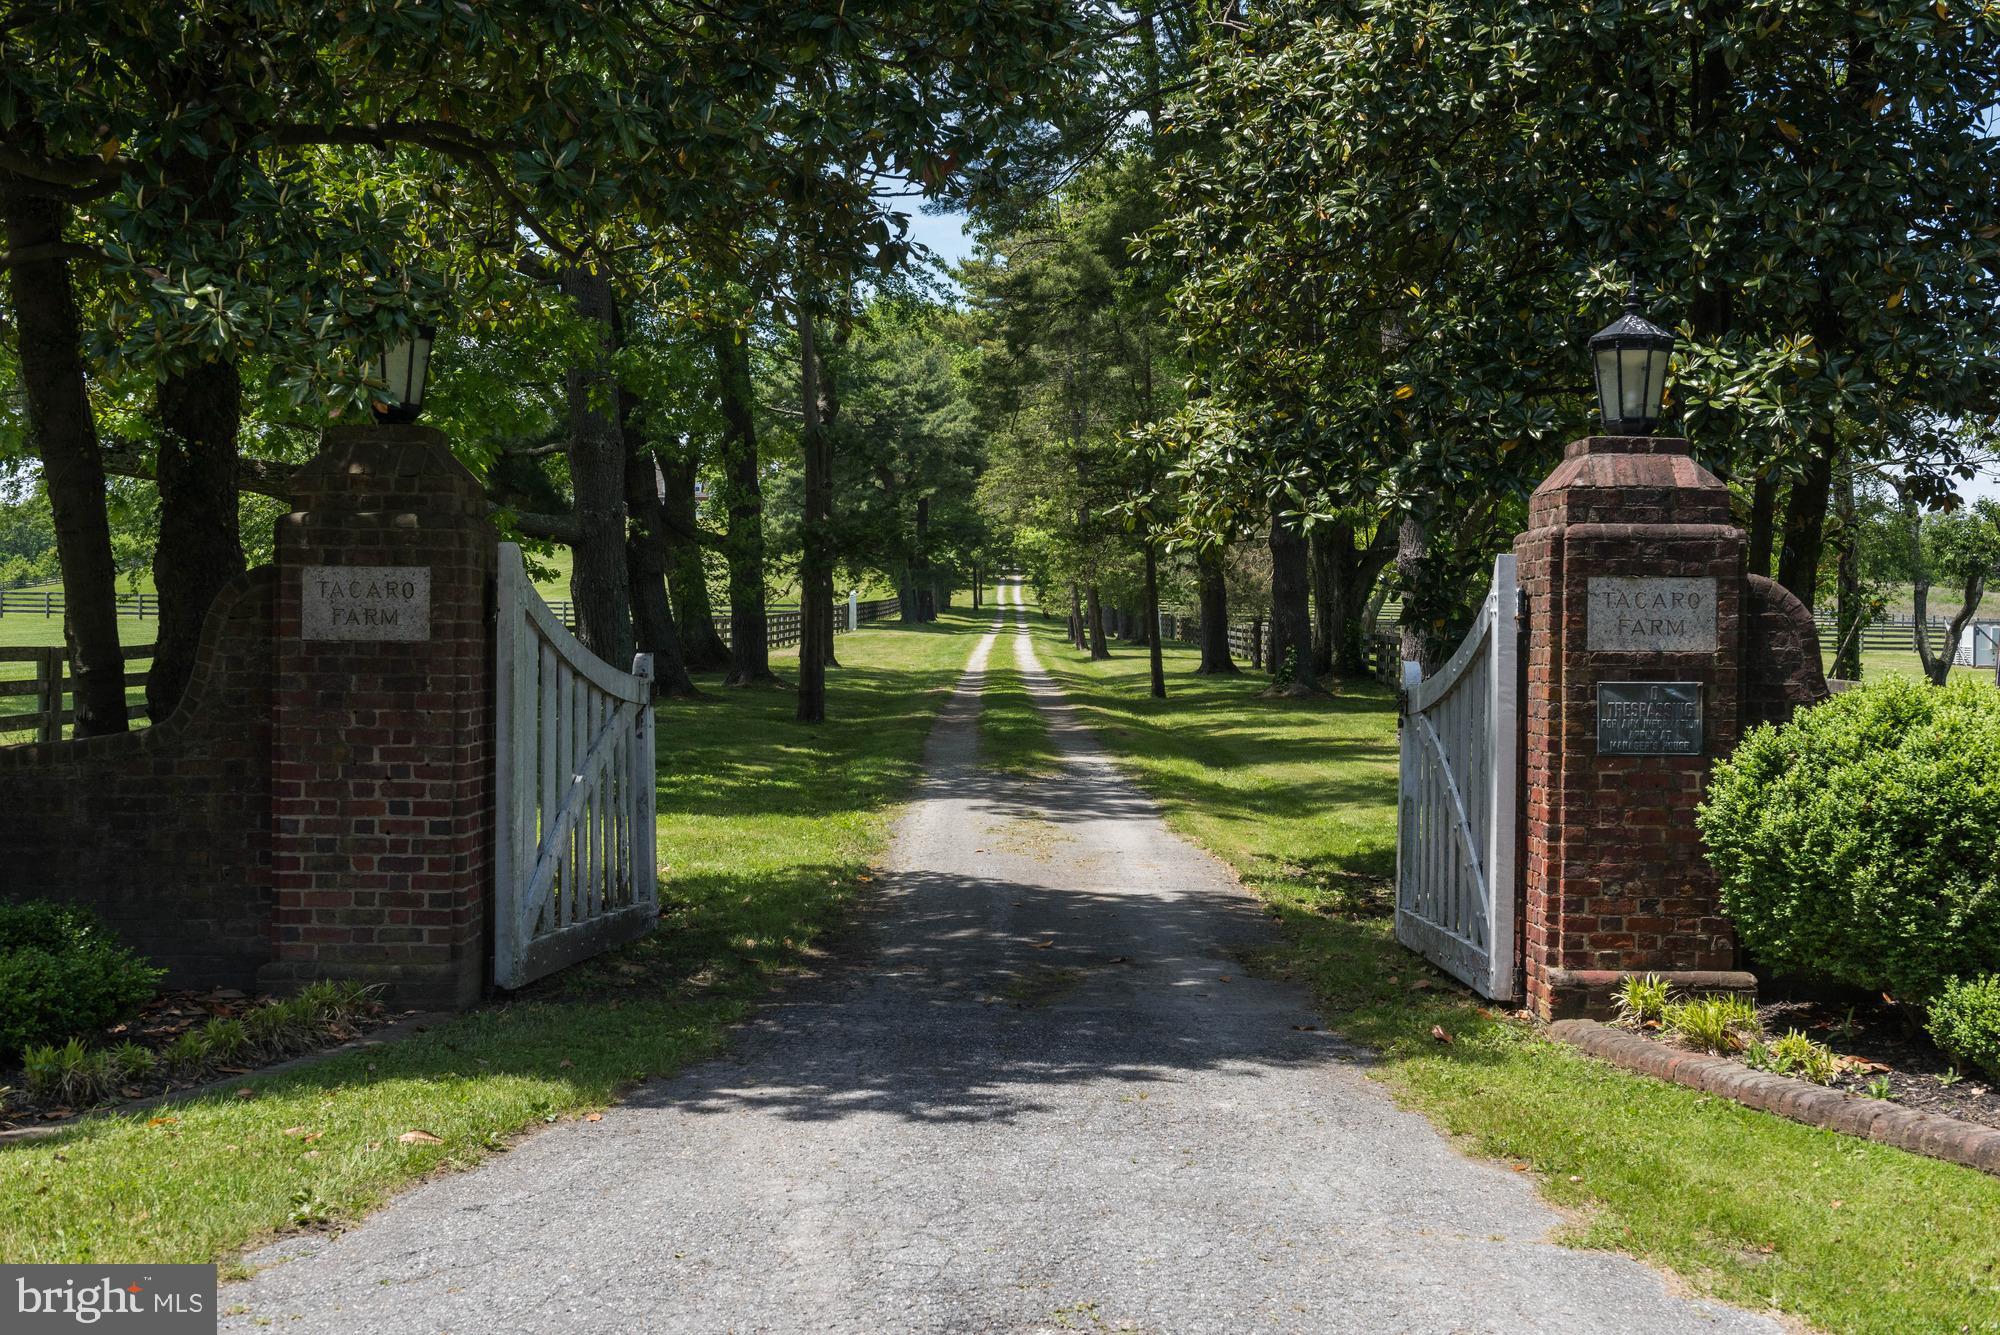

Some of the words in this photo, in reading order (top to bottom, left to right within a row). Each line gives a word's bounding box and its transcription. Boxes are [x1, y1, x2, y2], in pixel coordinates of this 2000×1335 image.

[316, 580, 415, 600] TACARO
[1601, 591, 1701, 610] TACARO
[332, 607, 399, 626] FARM
[1618, 618, 1685, 637] FARM
[1607, 701, 1696, 718] TRESPASSING
